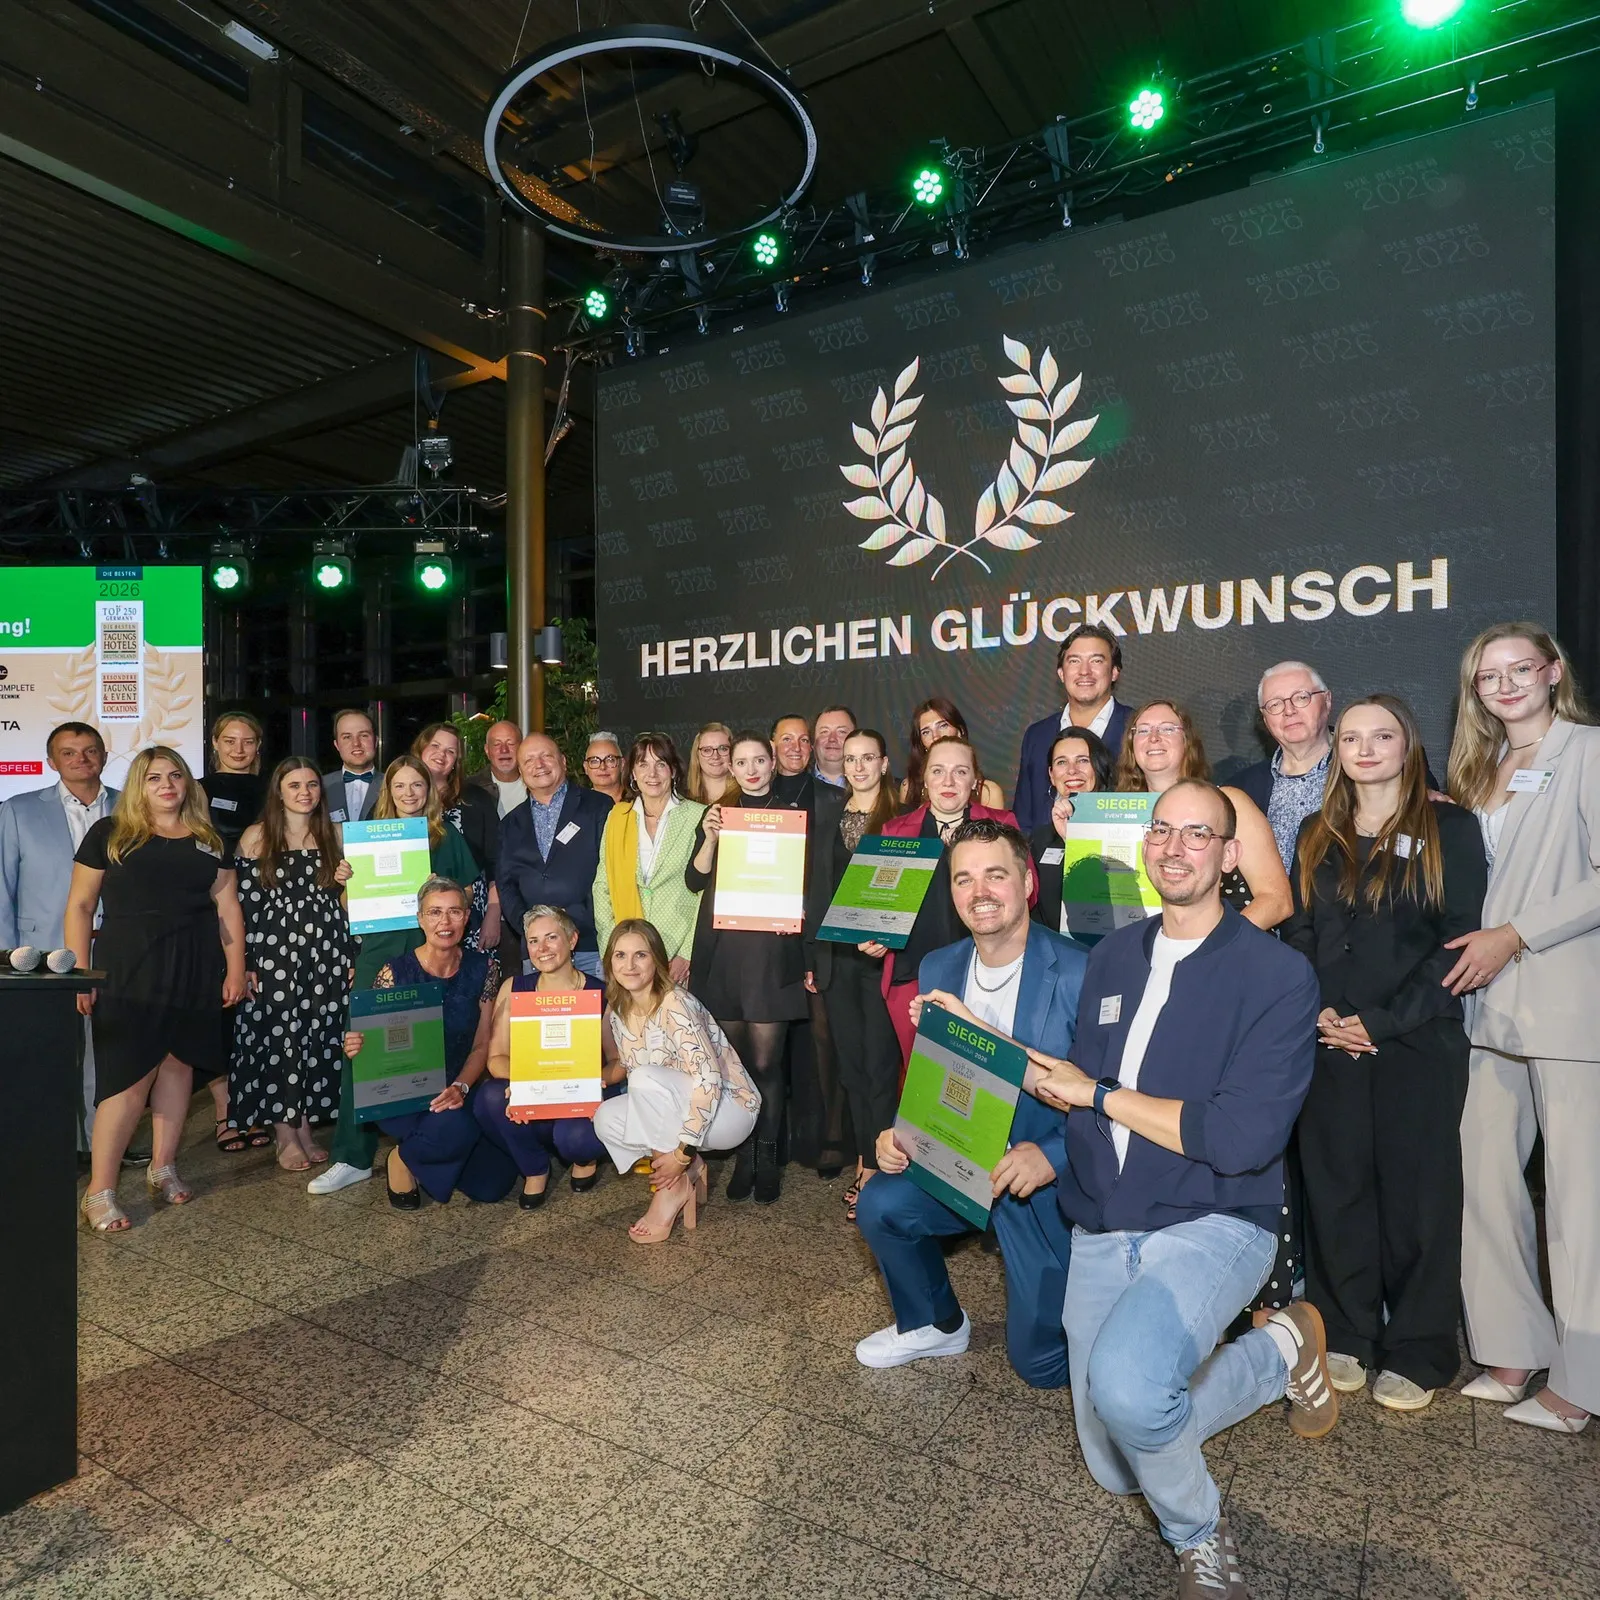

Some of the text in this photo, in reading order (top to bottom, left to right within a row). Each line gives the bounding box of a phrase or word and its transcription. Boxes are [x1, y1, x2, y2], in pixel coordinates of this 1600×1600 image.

[1505, 125, 1555, 170] 20
[1354, 169, 1447, 210] 2026
[1221, 208, 1303, 245] 2026
[1103, 242, 1175, 277] 2026
[1393, 234, 1489, 274] 2026
[997, 273, 1062, 305] 2026
[1256, 270, 1340, 306] 2026
[901, 301, 960, 330] 2026
[1134, 301, 1209, 334] 2026
[1434, 301, 1534, 340] 2026
[815, 326, 868, 353] 2026
[1292, 333, 1379, 368] 2026
[737, 348, 785, 374] 2026
[926, 354, 987, 383] 2026
[665, 369, 709, 393] 2026
[1165, 362, 1243, 394] 2026
[1476, 371, 1555, 408] 202
[599, 388, 640, 410] 2026
[757, 397, 807, 422] 2026
[684, 416, 729, 439] 2026
[617, 433, 658, 455] 2026
[778, 447, 829, 471] 2026
[703, 464, 750, 487] 2026
[634, 479, 677, 500] 2026
[723, 513, 771, 535] 2026
[652, 526, 696, 547] 2026
[598, 539, 628, 558] 026
[671, 574, 716, 594] 2026
[743, 563, 792, 584] 2026
[100, 583, 140, 596] 2026
[605, 585, 646, 603] 2026
[102, 608, 137, 616] TOP 250
[641, 558, 1448, 678] HERZLICHEN GLÜCKWUNSCH
[104, 641, 137, 650] HOTELS
[103, 684, 137, 692] TAGUNGS
[1, 721, 21, 730] TA
[1096, 798, 1147, 810] SIEGER
[366, 823, 405, 833] SIEGER
[744, 812, 783, 823] SIEGER
[880, 840, 920, 849] SIEGER
[376, 990, 418, 1003] SIEGER
[535, 996, 576, 1006] SIEGER
[947, 1021, 996, 1056] SIEGER
[974, 1052, 988, 1063] 2026
